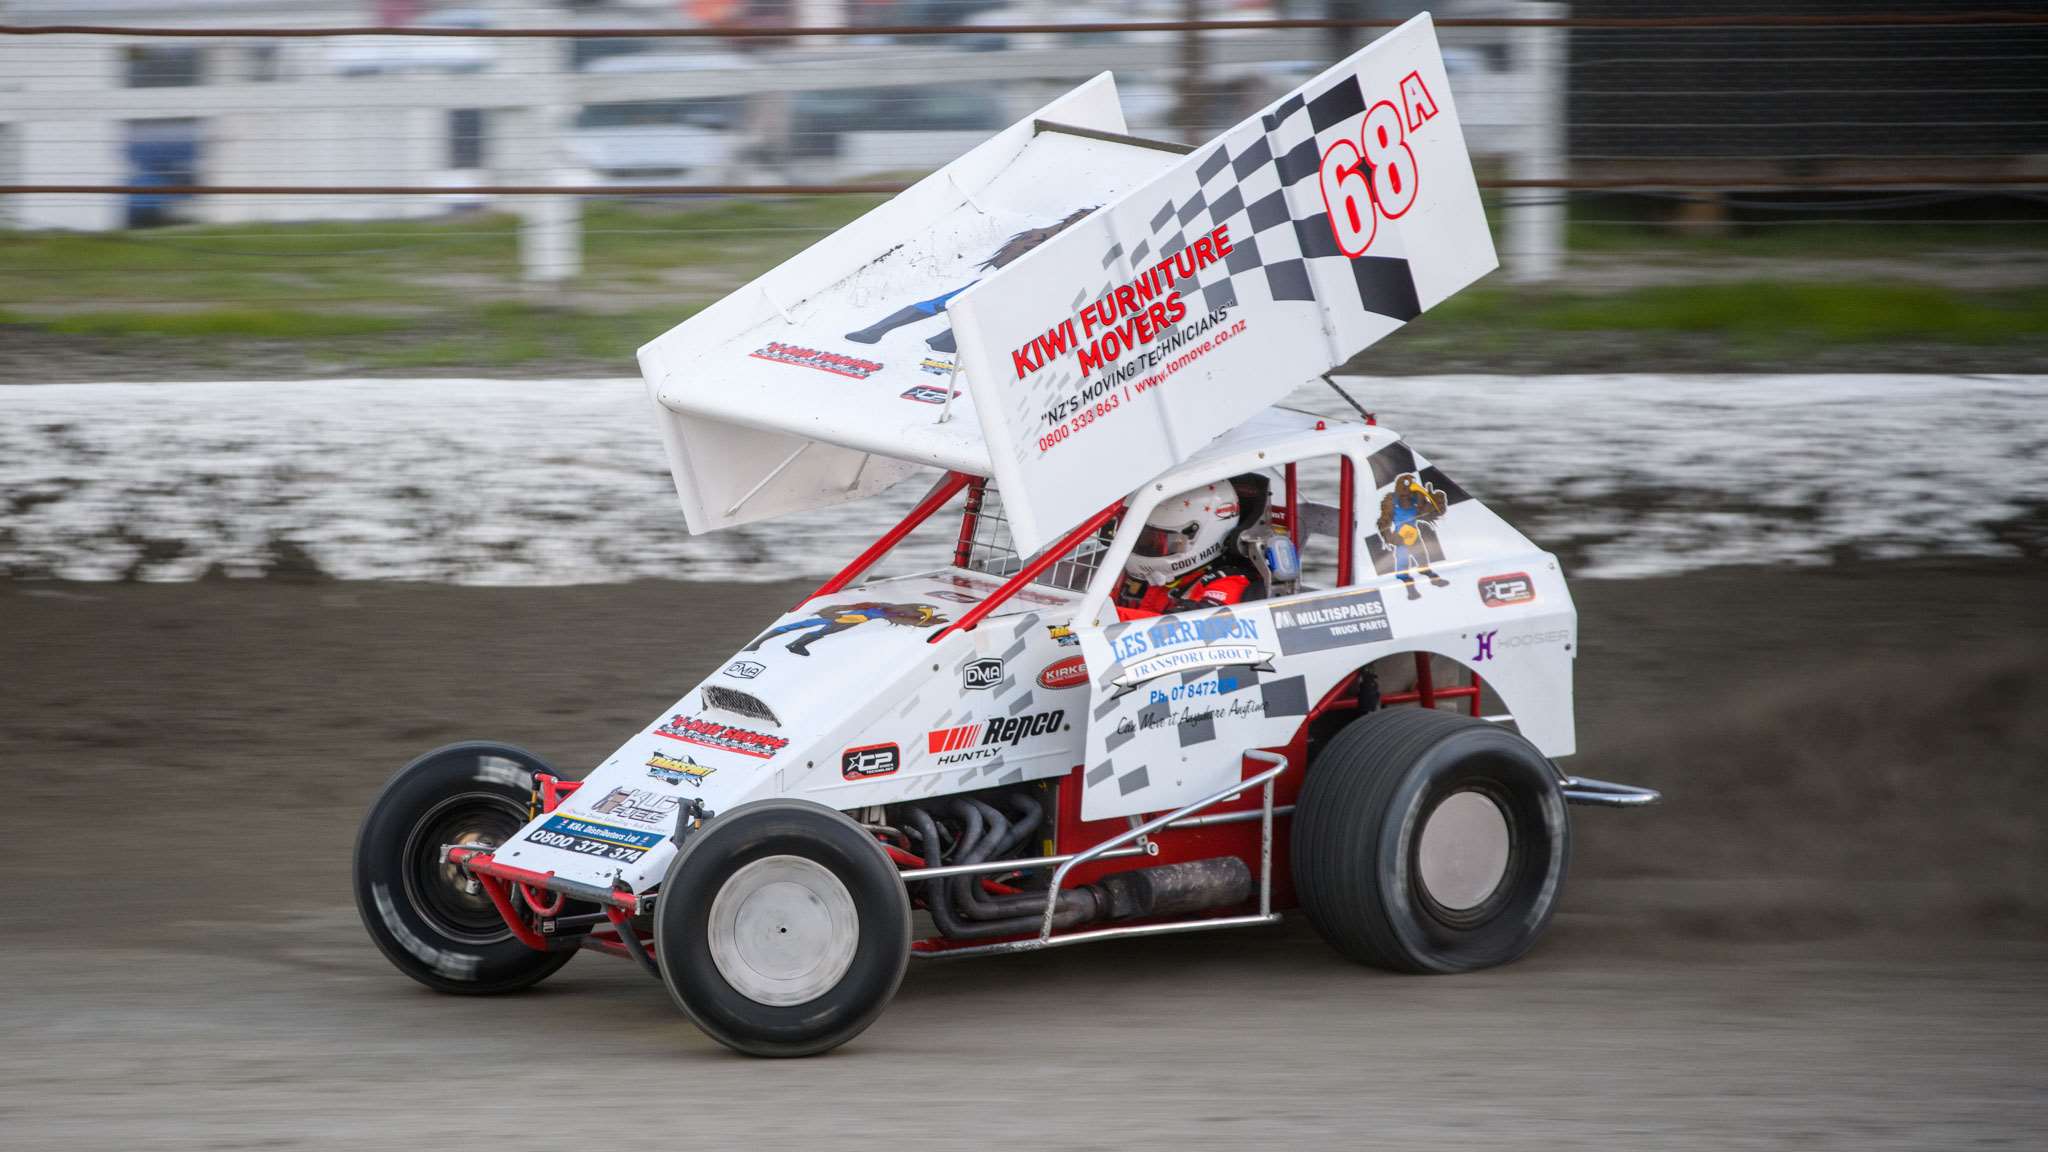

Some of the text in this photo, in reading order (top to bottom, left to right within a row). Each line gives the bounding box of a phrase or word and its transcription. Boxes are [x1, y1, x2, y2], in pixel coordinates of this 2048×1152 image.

[1011, 223, 1234, 380] KIWI FURNITURE
[1077, 291, 1187, 378] MOVERS
[1082, 361, 1136, 406] MOVING
[1137, 301, 1235, 369] TECHNICIANS"
[1039, 319, 1247, 452] 0800 333 863 www.tomove.co.nz
[1170, 555, 1197, 571] CODY
[1296, 601, 1383, 625] MULTISPARES
[1329, 619, 1388, 636] TRUCK PARTS
[1498, 629, 1569, 648] HOOSIER
[1111, 631, 1148, 664] LES
[967, 665, 1001, 683] DMA
[1134, 648, 1252, 678] TRANSPORT GROUP
[981, 709, 1065, 746] Repco
[1167, 712, 1178, 726] it
[858, 751, 893, 771] CP
[937, 746, 1002, 765] HUNTLY
[585, 824, 625, 841] Distributors
[624, 832, 640, 843] Ltd
[529, 829, 642, 863] 0800 372 374
